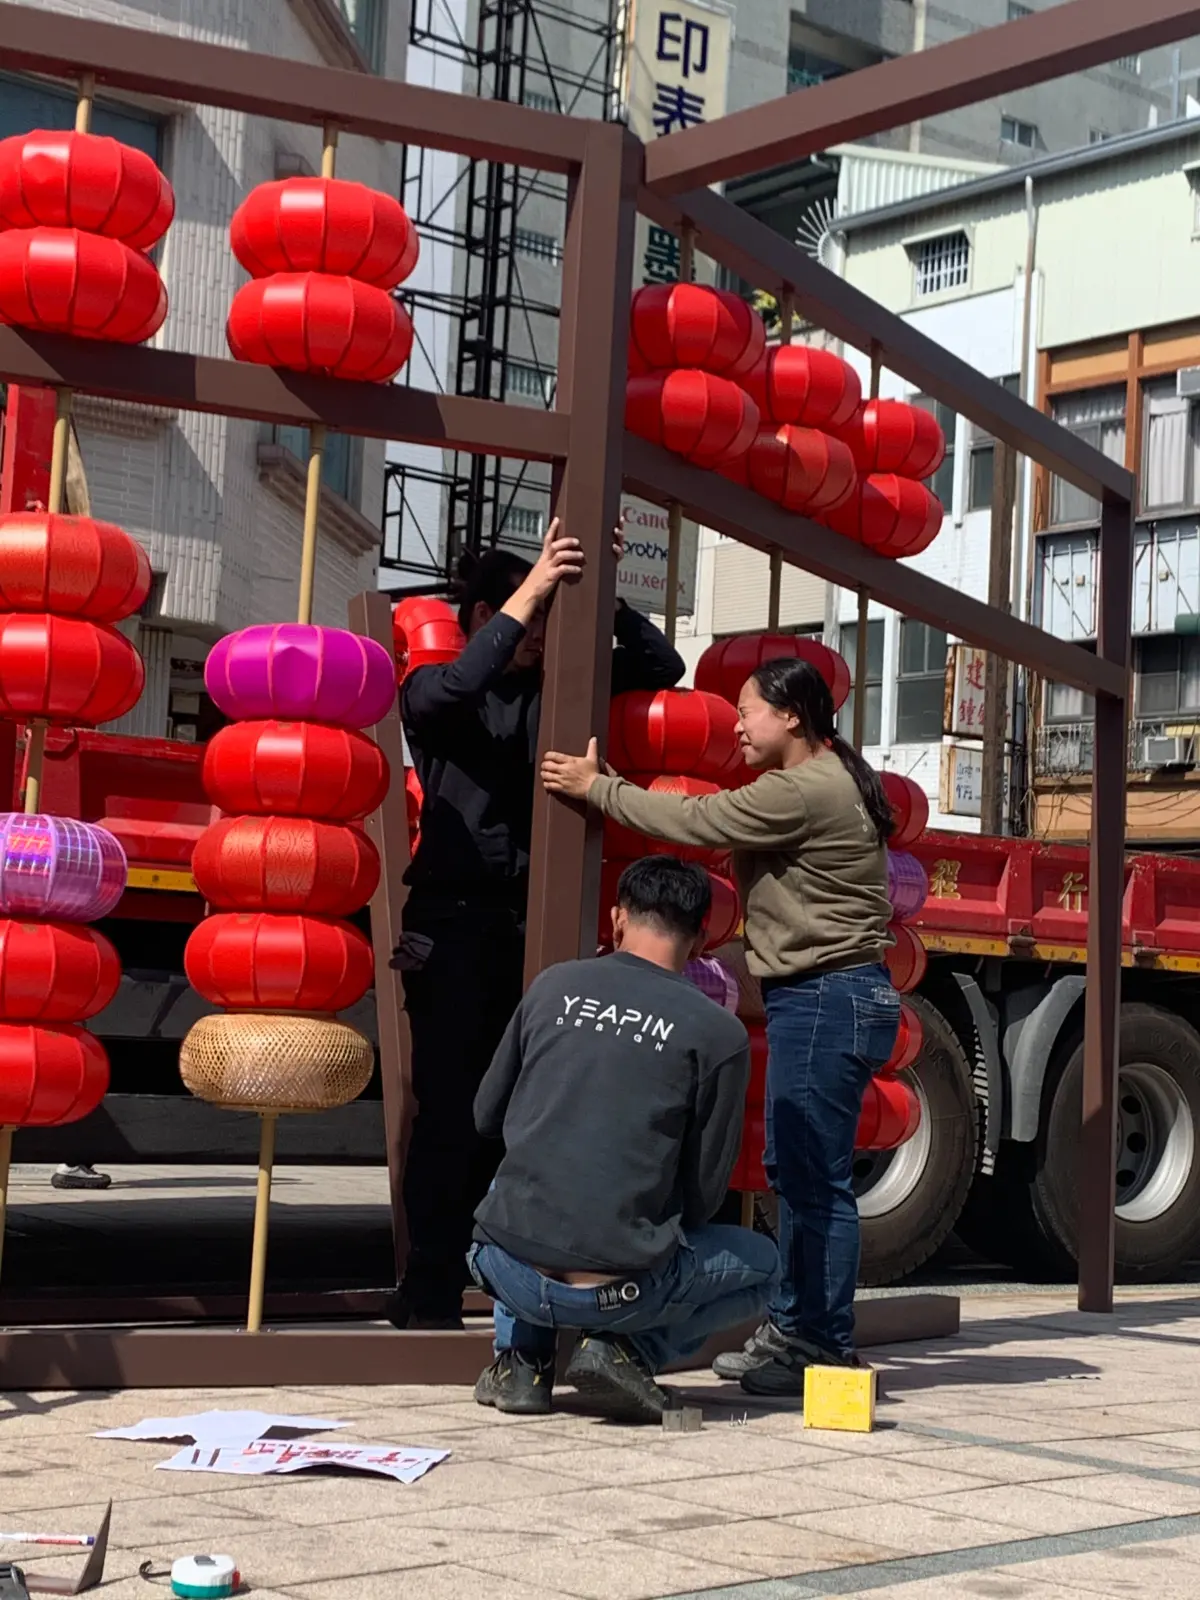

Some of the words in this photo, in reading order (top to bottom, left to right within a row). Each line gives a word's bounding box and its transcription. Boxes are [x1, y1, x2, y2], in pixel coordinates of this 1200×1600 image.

[622, 506, 669, 530] Cano
[622, 540, 669, 562] broth
[641, 573, 686, 594] xerx
[1058, 872, 1088, 913] 行
[563, 995, 675, 1041] YEAPIN
[556, 1017, 664, 1052] DESIGN
